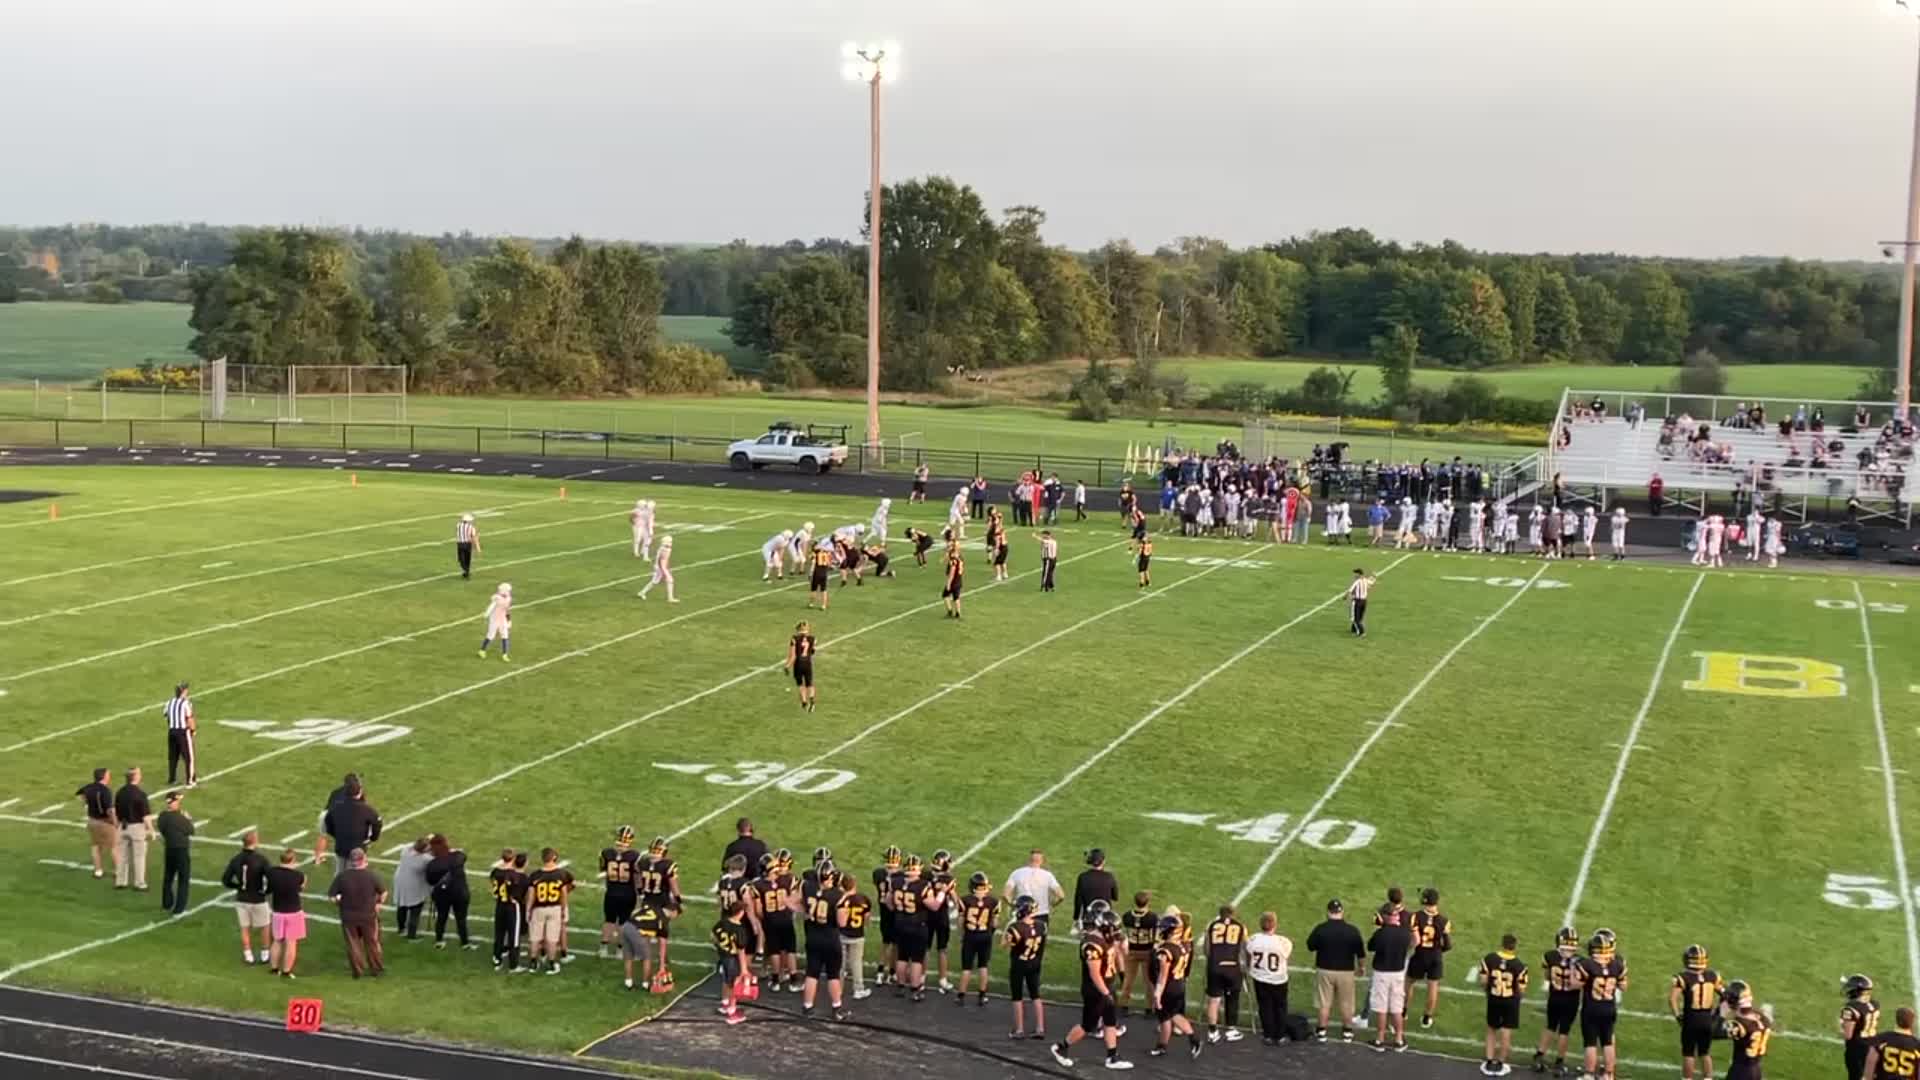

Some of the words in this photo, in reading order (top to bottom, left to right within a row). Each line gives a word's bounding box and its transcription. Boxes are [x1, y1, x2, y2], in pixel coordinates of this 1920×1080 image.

[1682, 650, 1848, 698] B
[252, 718, 415, 748] 20
[704, 760, 858, 794] 30
[1216, 813, 1377, 850] 40
[607, 861, 630, 883] 66
[642, 871, 662, 894] 77
[537, 881, 562, 903] 85
[1823, 872, 1920, 911] 5
[967, 907, 990, 931] 54
[1422, 925, 1435, 947] 2
[1253, 951, 1280, 972] 70
[1491, 969, 1513, 998] 32
[291, 1003, 317, 1026] 30
[1883, 1046, 1916, 1076] 55
